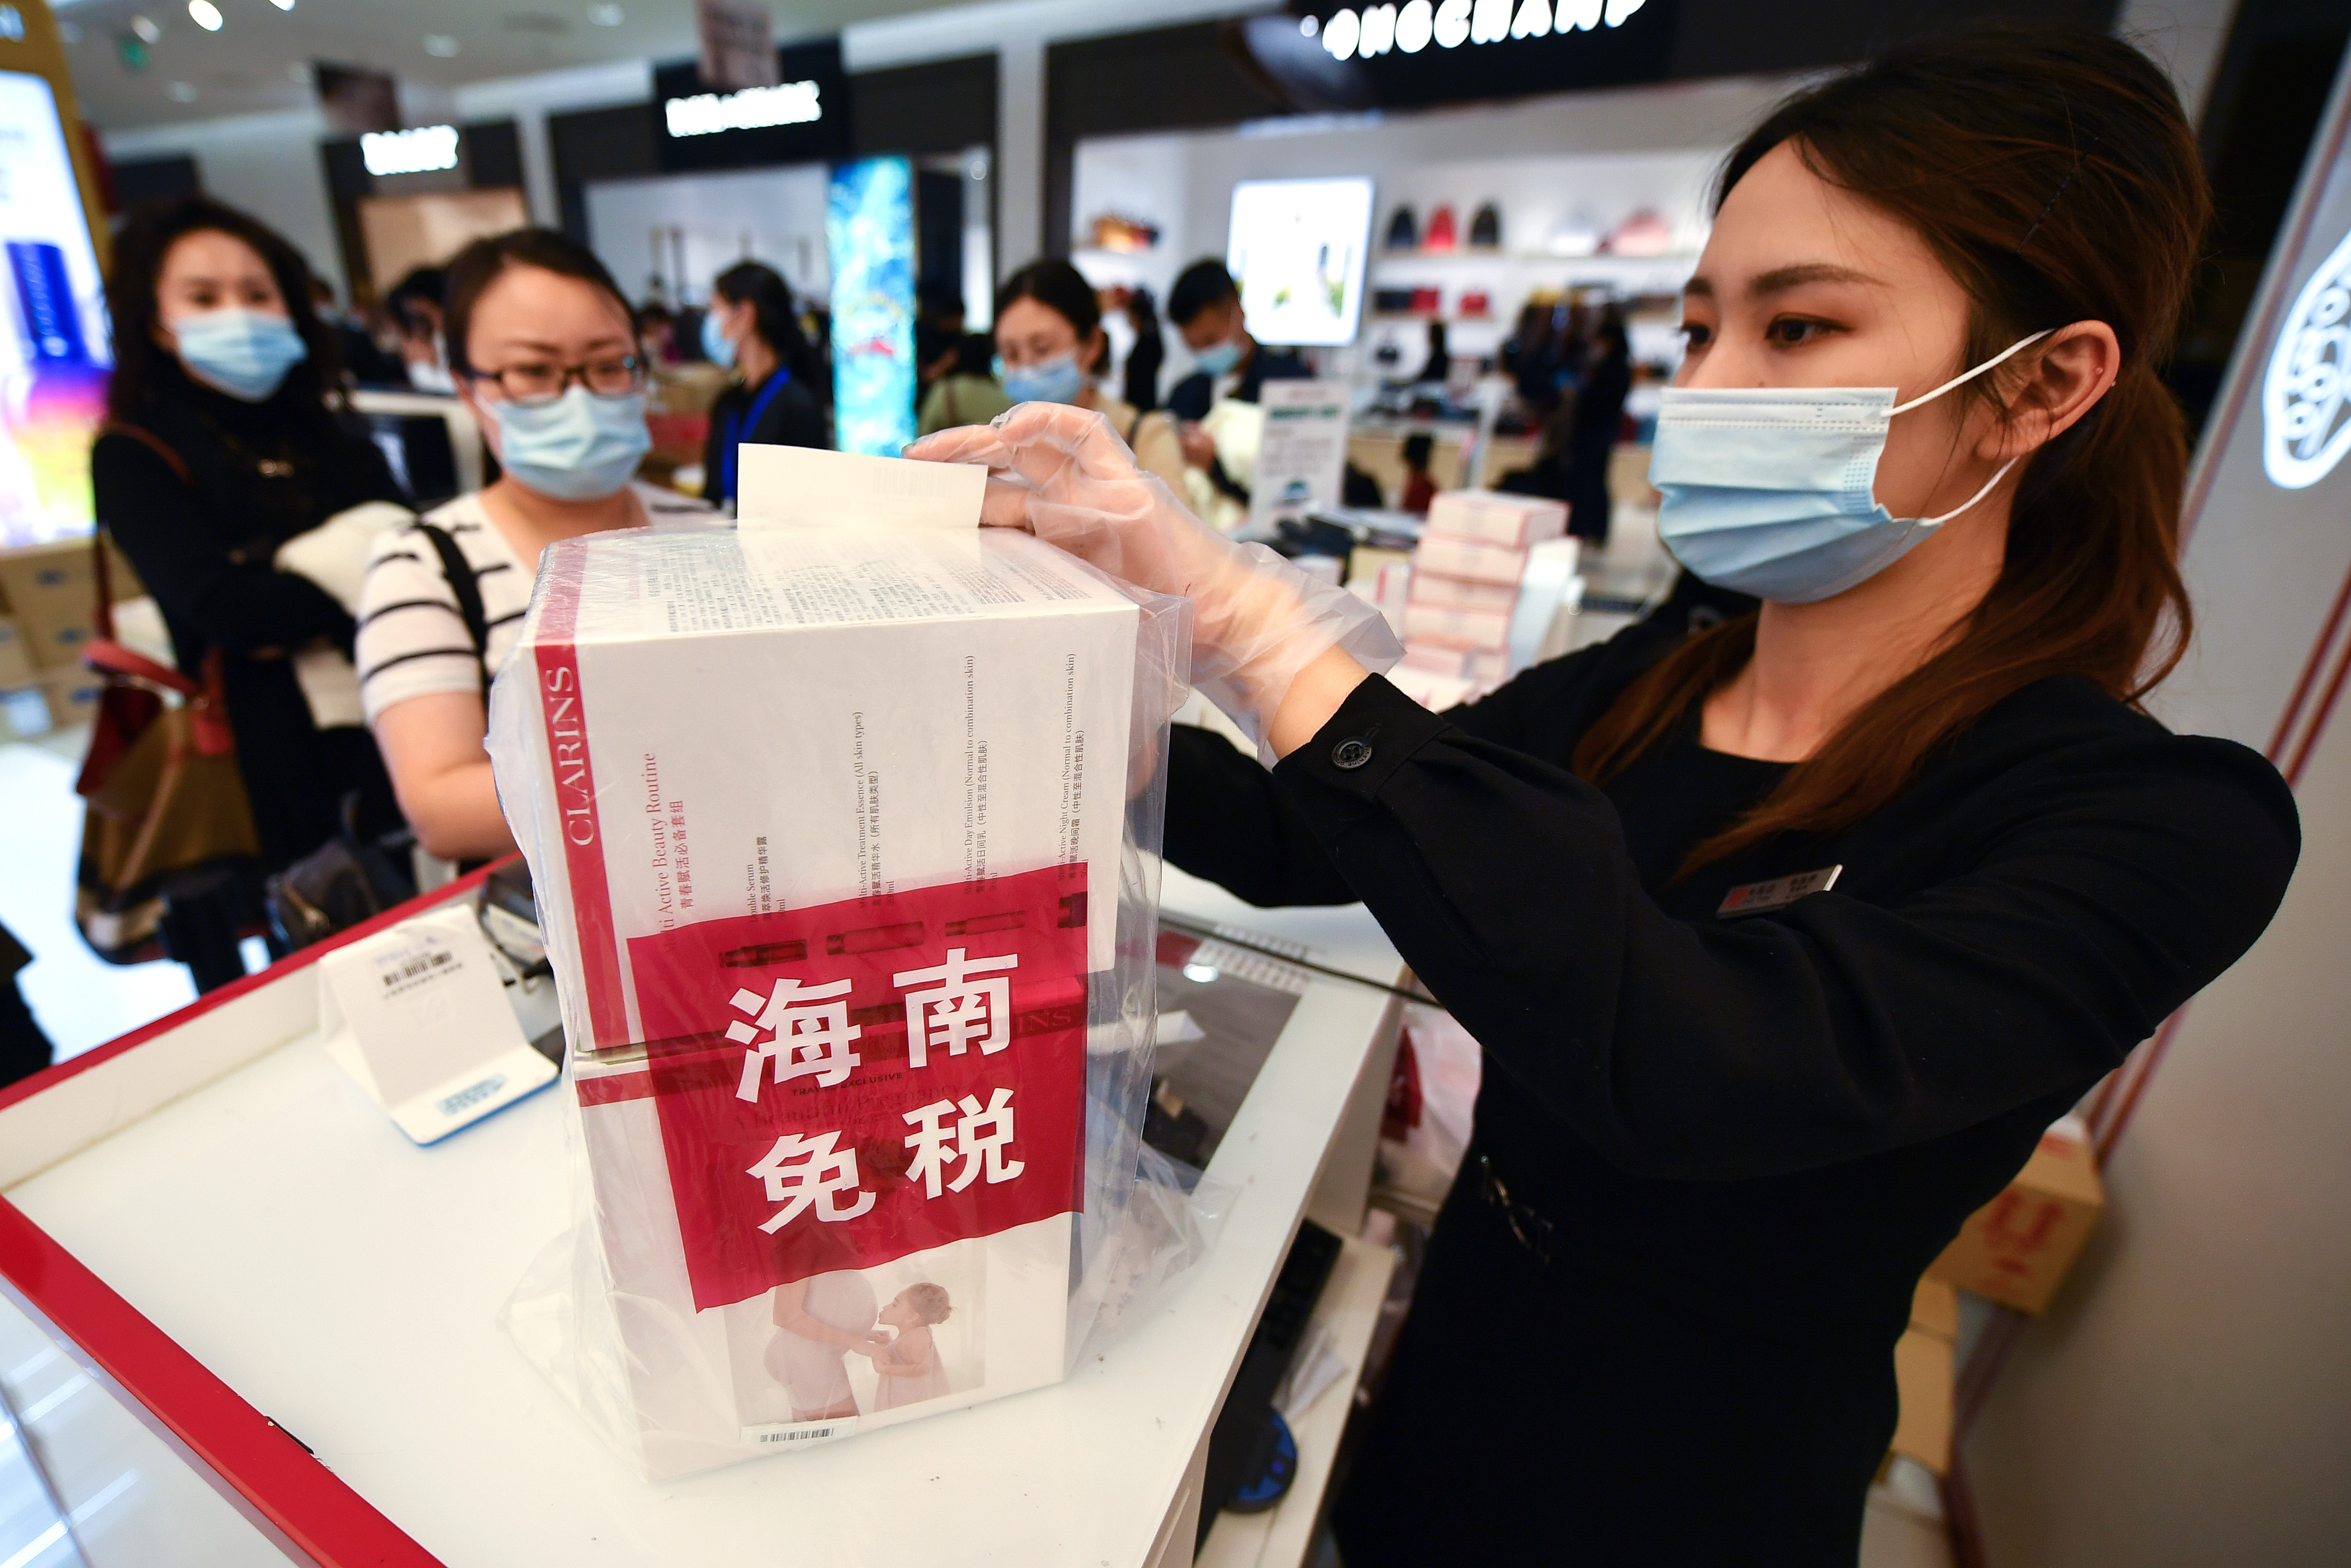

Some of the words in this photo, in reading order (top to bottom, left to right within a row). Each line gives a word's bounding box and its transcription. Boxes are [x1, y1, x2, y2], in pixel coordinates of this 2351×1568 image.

[1300, 0, 1648, 60] ONGCHAMP
[965, 655, 975, 678] skin)
[1066, 653, 1076, 676] skin)
[965, 681, 973, 737] combination
[1064, 678, 1074, 733] combination
[853, 711, 864, 738] types)
[545, 666, 595, 845] CLARINS
[854, 741, 863, 759] skin
[966, 740, 973, 749] to
[854, 761, 864, 777] (All
[965, 751, 974, 787] (Normal
[1062, 746, 1072, 780] (Normal
[641, 753, 661, 813] Routine
[856, 780, 864, 813] Essence
[1061, 782, 1070, 809] Cream
[965, 789, 973, 828] Emulsion
[1059, 811, 1070, 833] Night
[651, 818, 668, 868] Beauty
[669, 800, 694, 909] 青春赋活必备套组
[857, 815, 867, 859] Treatment
[965, 830, 974, 846] Day
[654, 872, 674, 914] Active
[746, 864, 756, 891] Serum
[724, 948, 1018, 1104] 海南
[792, 1085, 837, 1096] TRAV
[745, 1086, 1025, 1236] 免税
